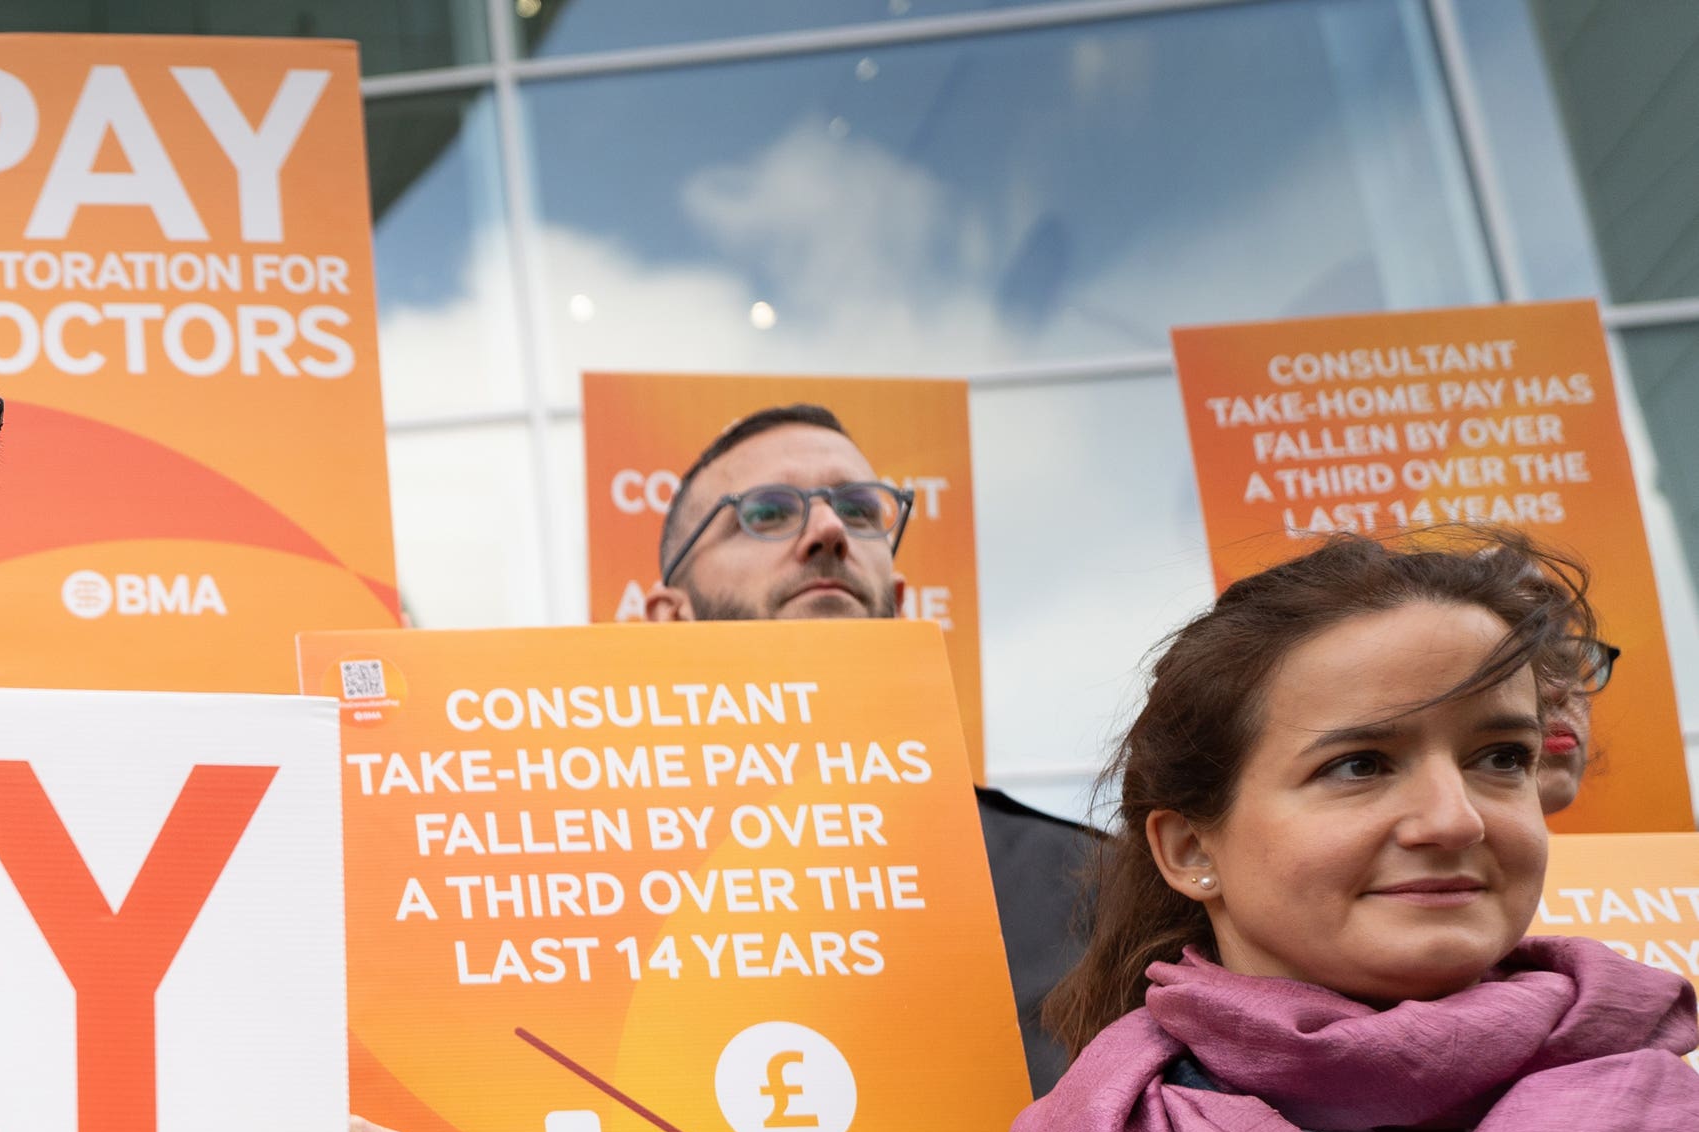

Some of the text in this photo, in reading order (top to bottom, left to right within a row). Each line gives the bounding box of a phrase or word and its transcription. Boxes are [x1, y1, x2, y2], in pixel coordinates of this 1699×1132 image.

[253, 254, 349, 296] FOR
[1267, 339, 1517, 387] CONSULTANT
[1206, 373, 1595, 428] TAKE-HOME PAY HAS
[1253, 413, 1564, 464] FALLEN BY OVER
[1243, 451, 1590, 504] A THIRD OVER THE
[1283, 492, 1566, 540] LAST 14 YEARS
[115, 574, 227, 616] BMA
[446, 681, 820, 734] CONSULTANT
[346, 740, 933, 796] TAKE-HOME PAY HAS
[415, 802, 887, 856] FALLEN BY OVER
[395, 865, 926, 921] A THIRD OVER THE
[454, 930, 885, 985] LAST 14 YEARS
